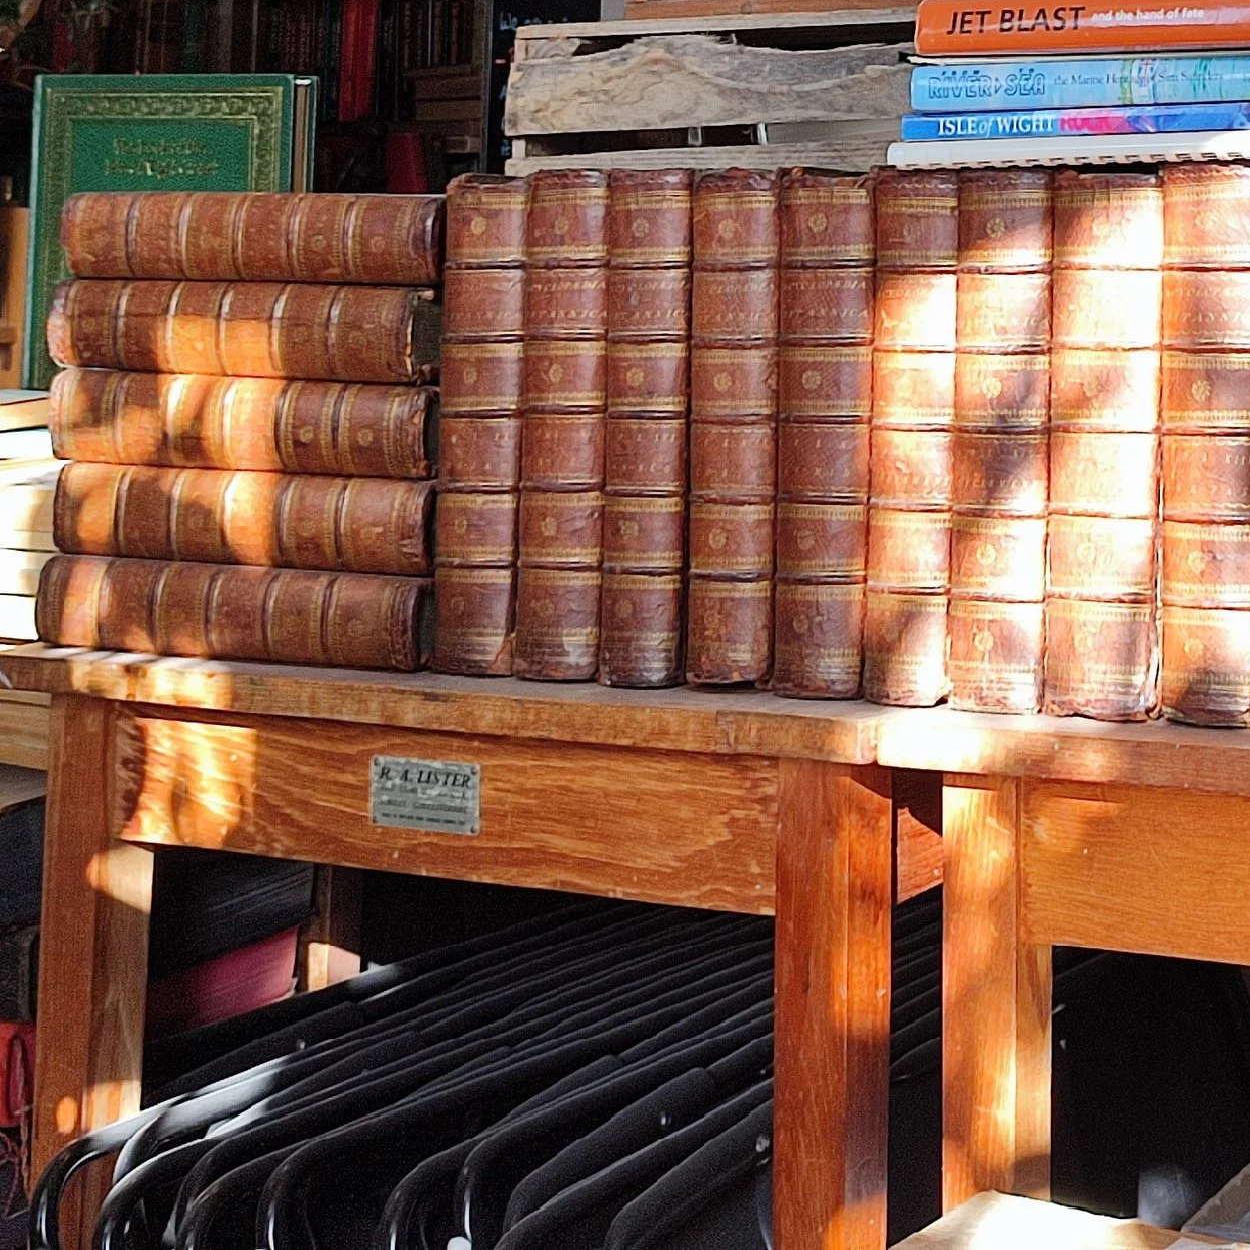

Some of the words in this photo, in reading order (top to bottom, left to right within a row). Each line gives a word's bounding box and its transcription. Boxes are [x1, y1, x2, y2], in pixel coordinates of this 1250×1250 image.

[946, 10, 992, 35] JET
[998, 6, 1086, 33] BLAST
[1091, 10, 1113, 23] and
[1115, 9, 1134, 22] the
[1136, 8, 1165, 21] hand
[1166, 8, 1180, 20] of
[1181, 7, 1205, 19] fate
[928, 70, 994, 99] RIVER
[1004, 69, 1046, 96] SEA
[1070, 74, 1104, 85] Marine
[937, 116, 975, 136] ISLE
[978, 116, 992, 137] of
[996, 114, 1056, 134] WIGHT
[417, 769, 471, 788] LISTER
